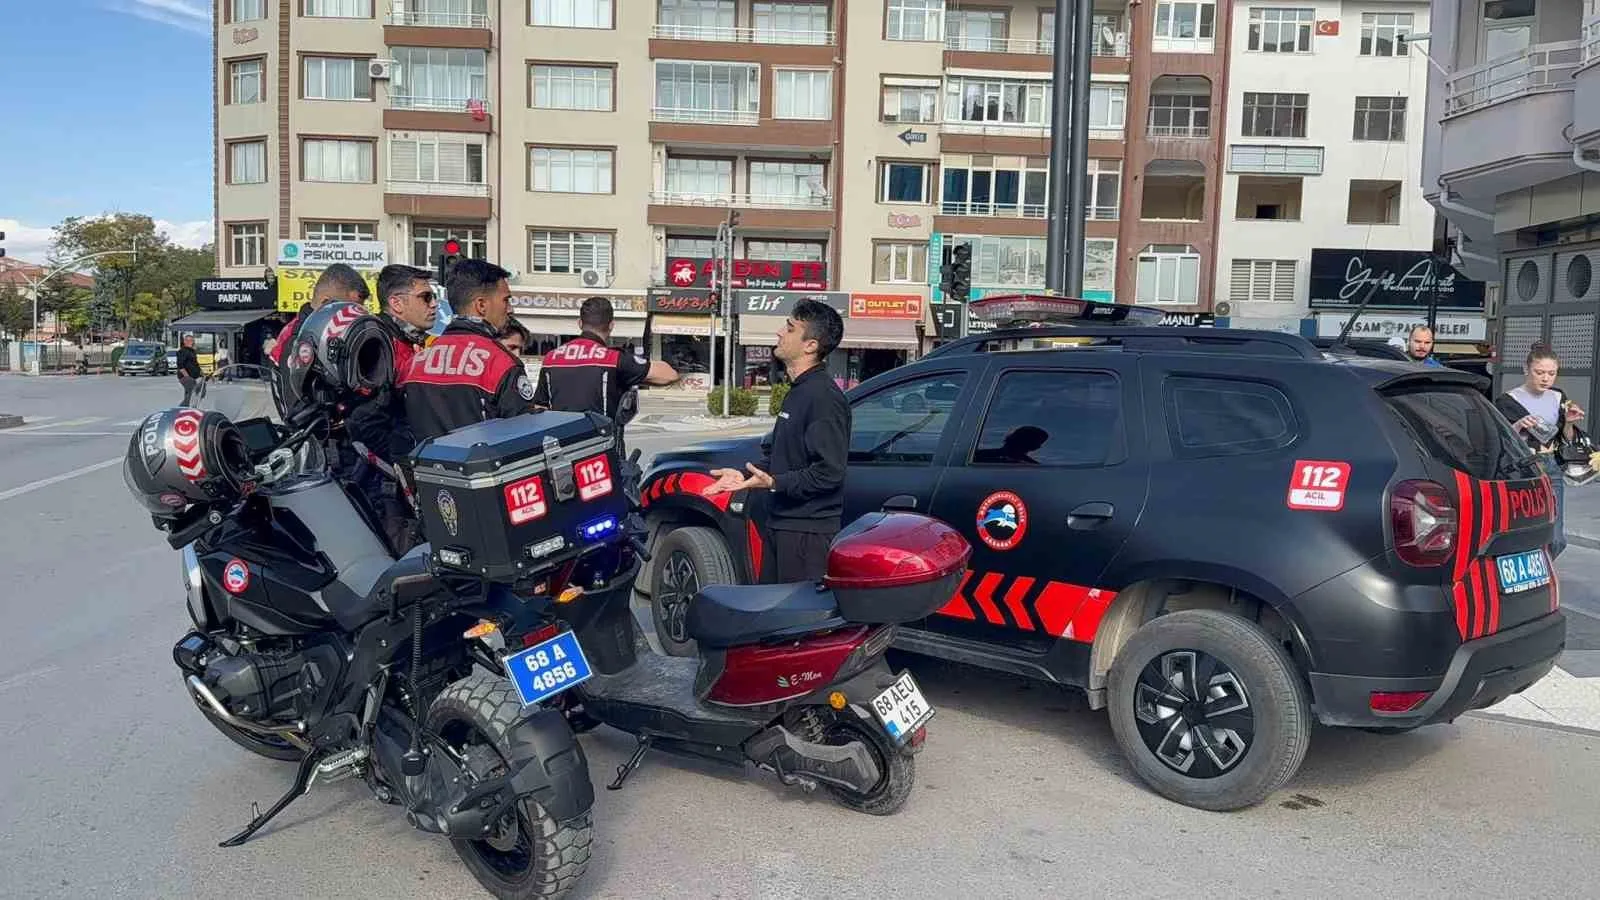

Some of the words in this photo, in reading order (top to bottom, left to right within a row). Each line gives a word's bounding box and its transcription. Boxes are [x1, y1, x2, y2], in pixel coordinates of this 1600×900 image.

[201, 281, 239, 291] FREDERIC
[217, 293, 252, 303] PARFUM
[747, 295, 784, 312] Elif
[407, 341, 491, 377] POLİS
[551, 343, 608, 361] POLİS
[579, 461, 607, 485] 112
[1301, 465, 1342, 488] 112
[510, 482, 541, 507] 112
[1501, 558, 1518, 584] 68
[1517, 556, 1528, 581] A
[524, 650, 550, 672] 68
[552, 643, 567, 661] A
[532, 661, 577, 691] 4856
[876, 695, 893, 716] 68
[900, 700, 922, 725] 415
